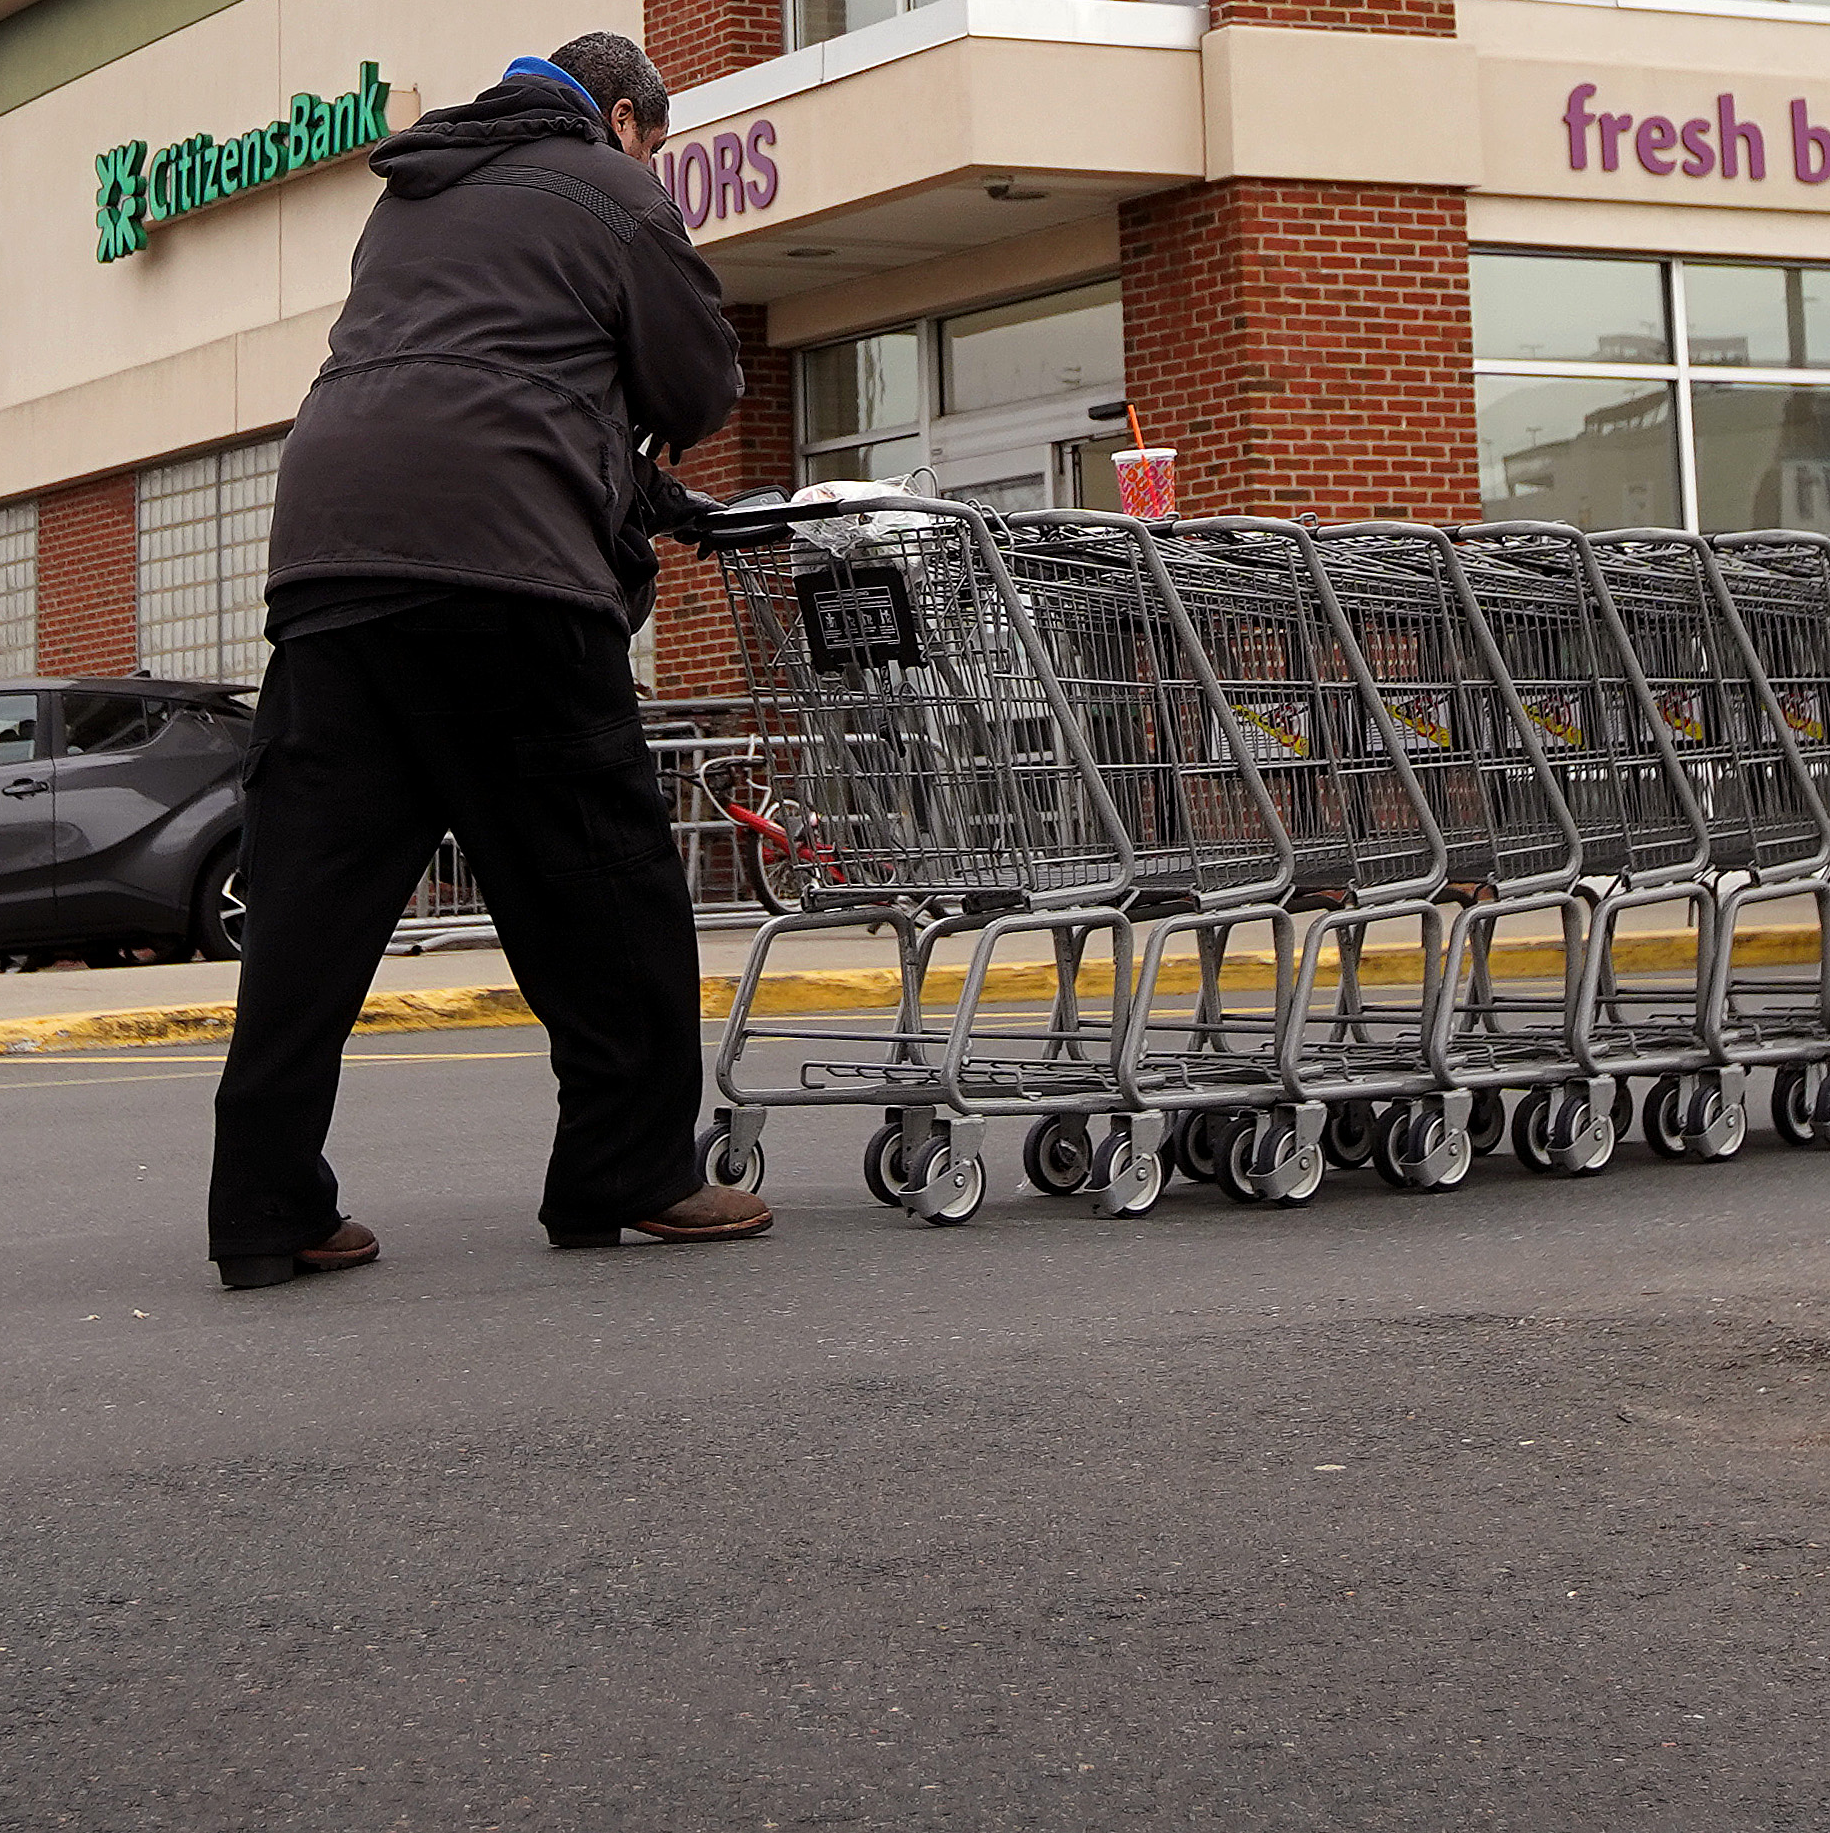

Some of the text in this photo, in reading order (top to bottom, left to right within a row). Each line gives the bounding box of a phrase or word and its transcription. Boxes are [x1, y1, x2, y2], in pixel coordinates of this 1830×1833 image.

[148, 60, 391, 222] Citizens Bank
[1562, 82, 1766, 181] fresh
